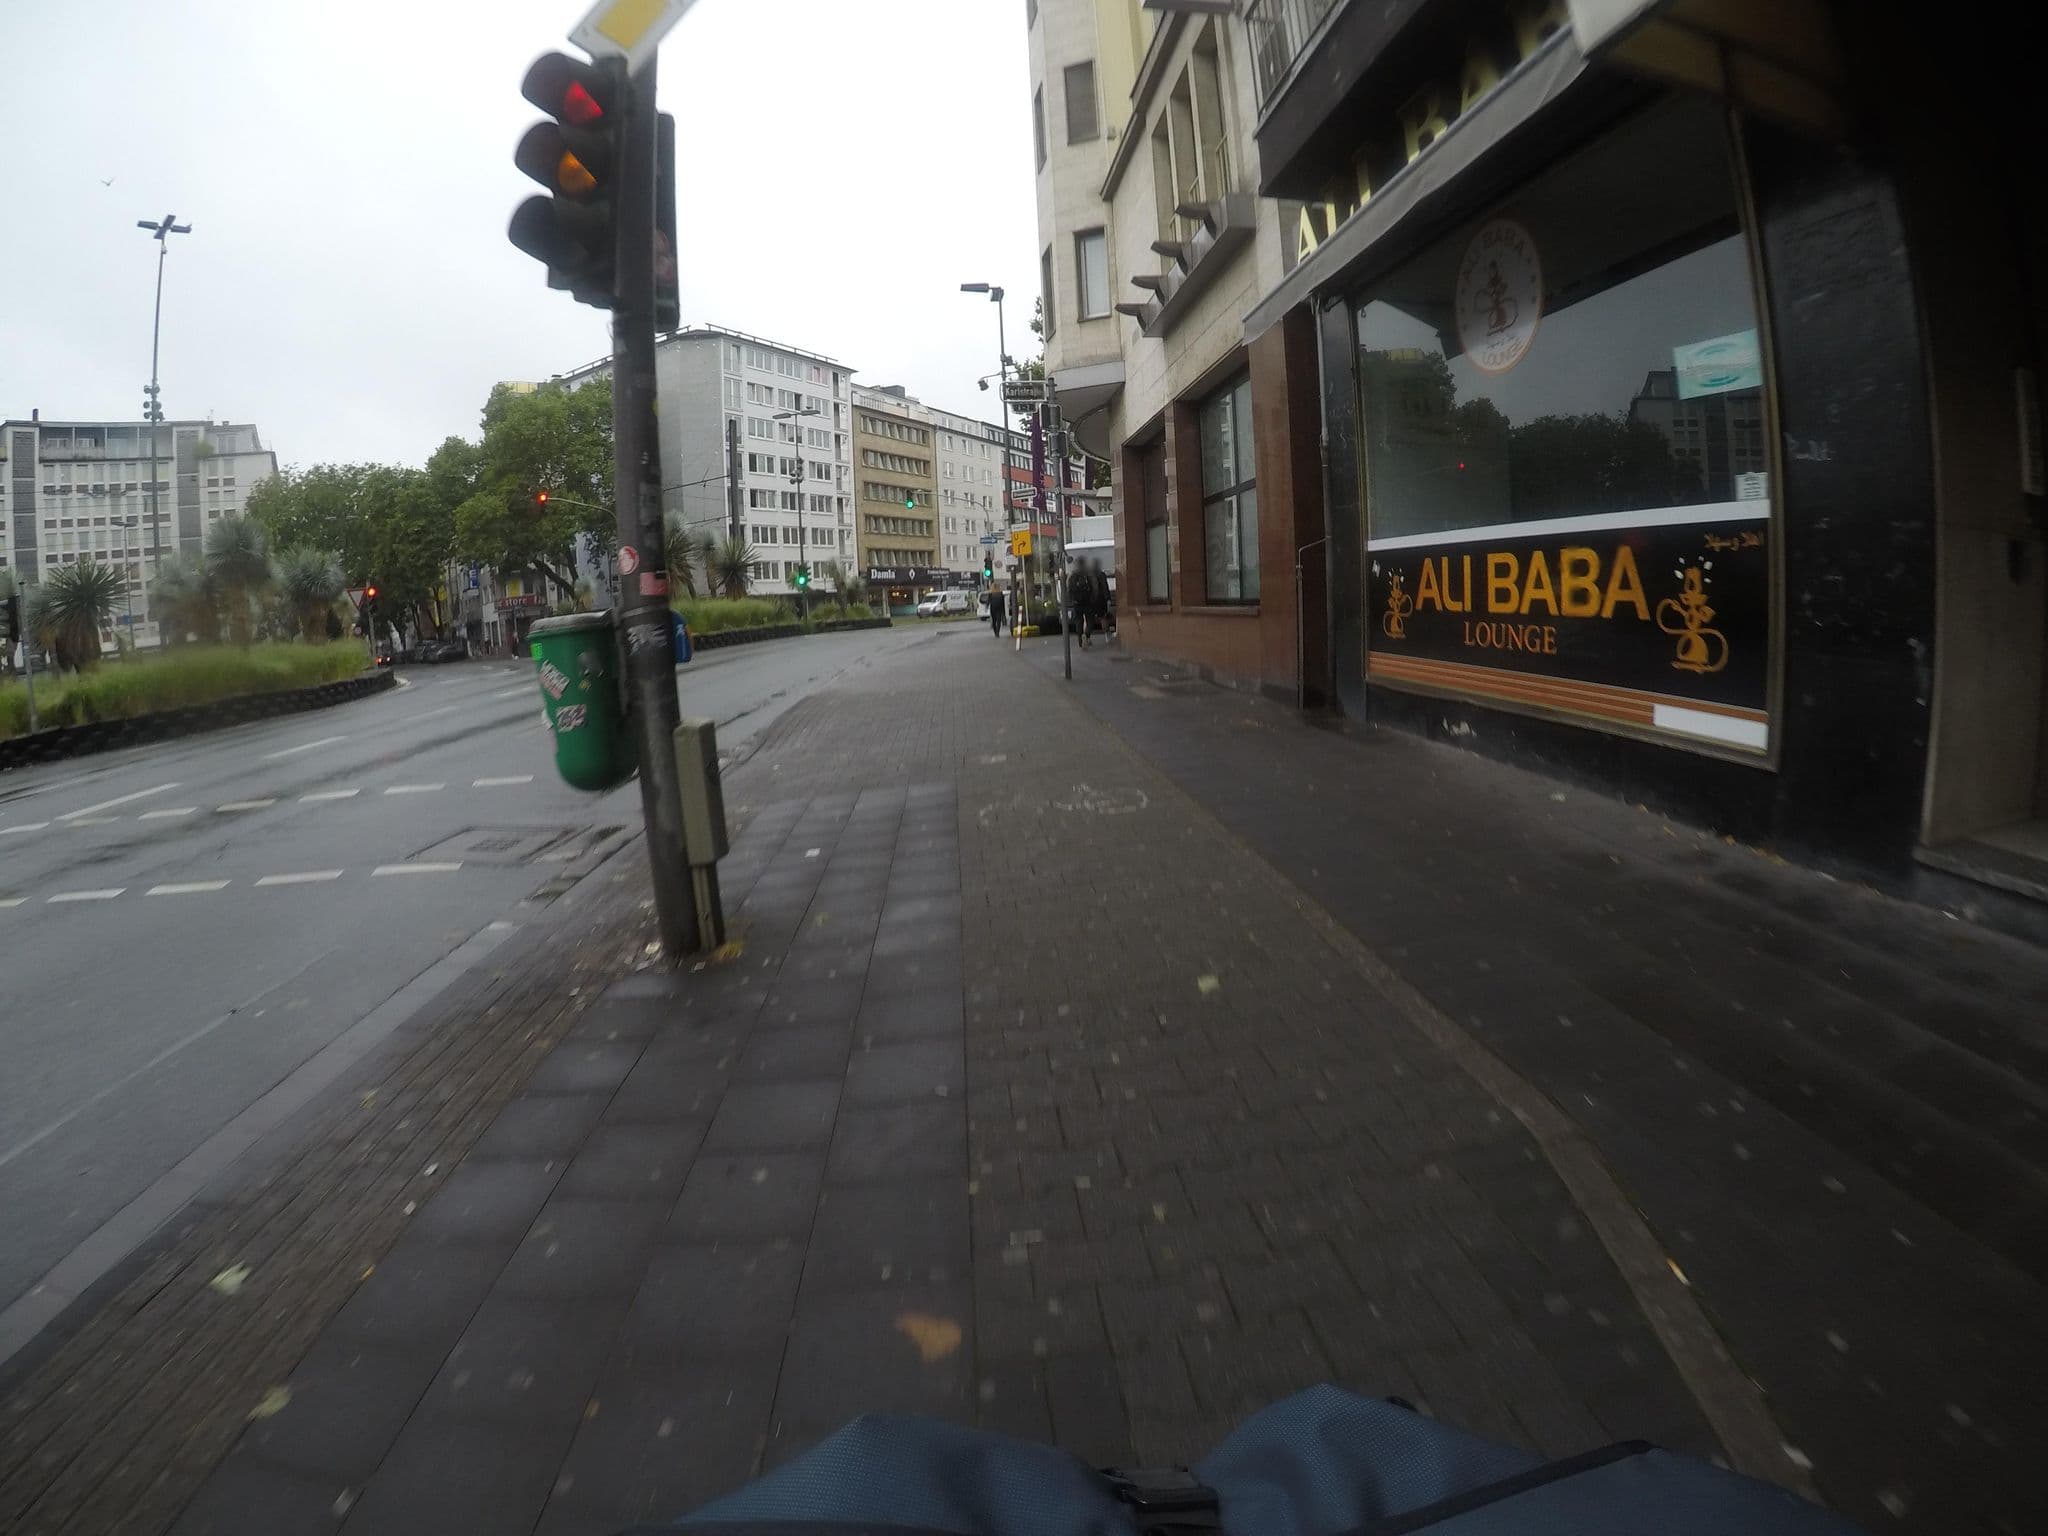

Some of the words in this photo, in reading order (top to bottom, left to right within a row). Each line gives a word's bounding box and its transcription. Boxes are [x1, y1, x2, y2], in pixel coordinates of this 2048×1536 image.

[870, 568, 896, 580] Damla
[1415, 554, 1473, 613] ALI
[1485, 544, 1652, 622] BABA
[1463, 621, 1558, 656] LOUNGE
